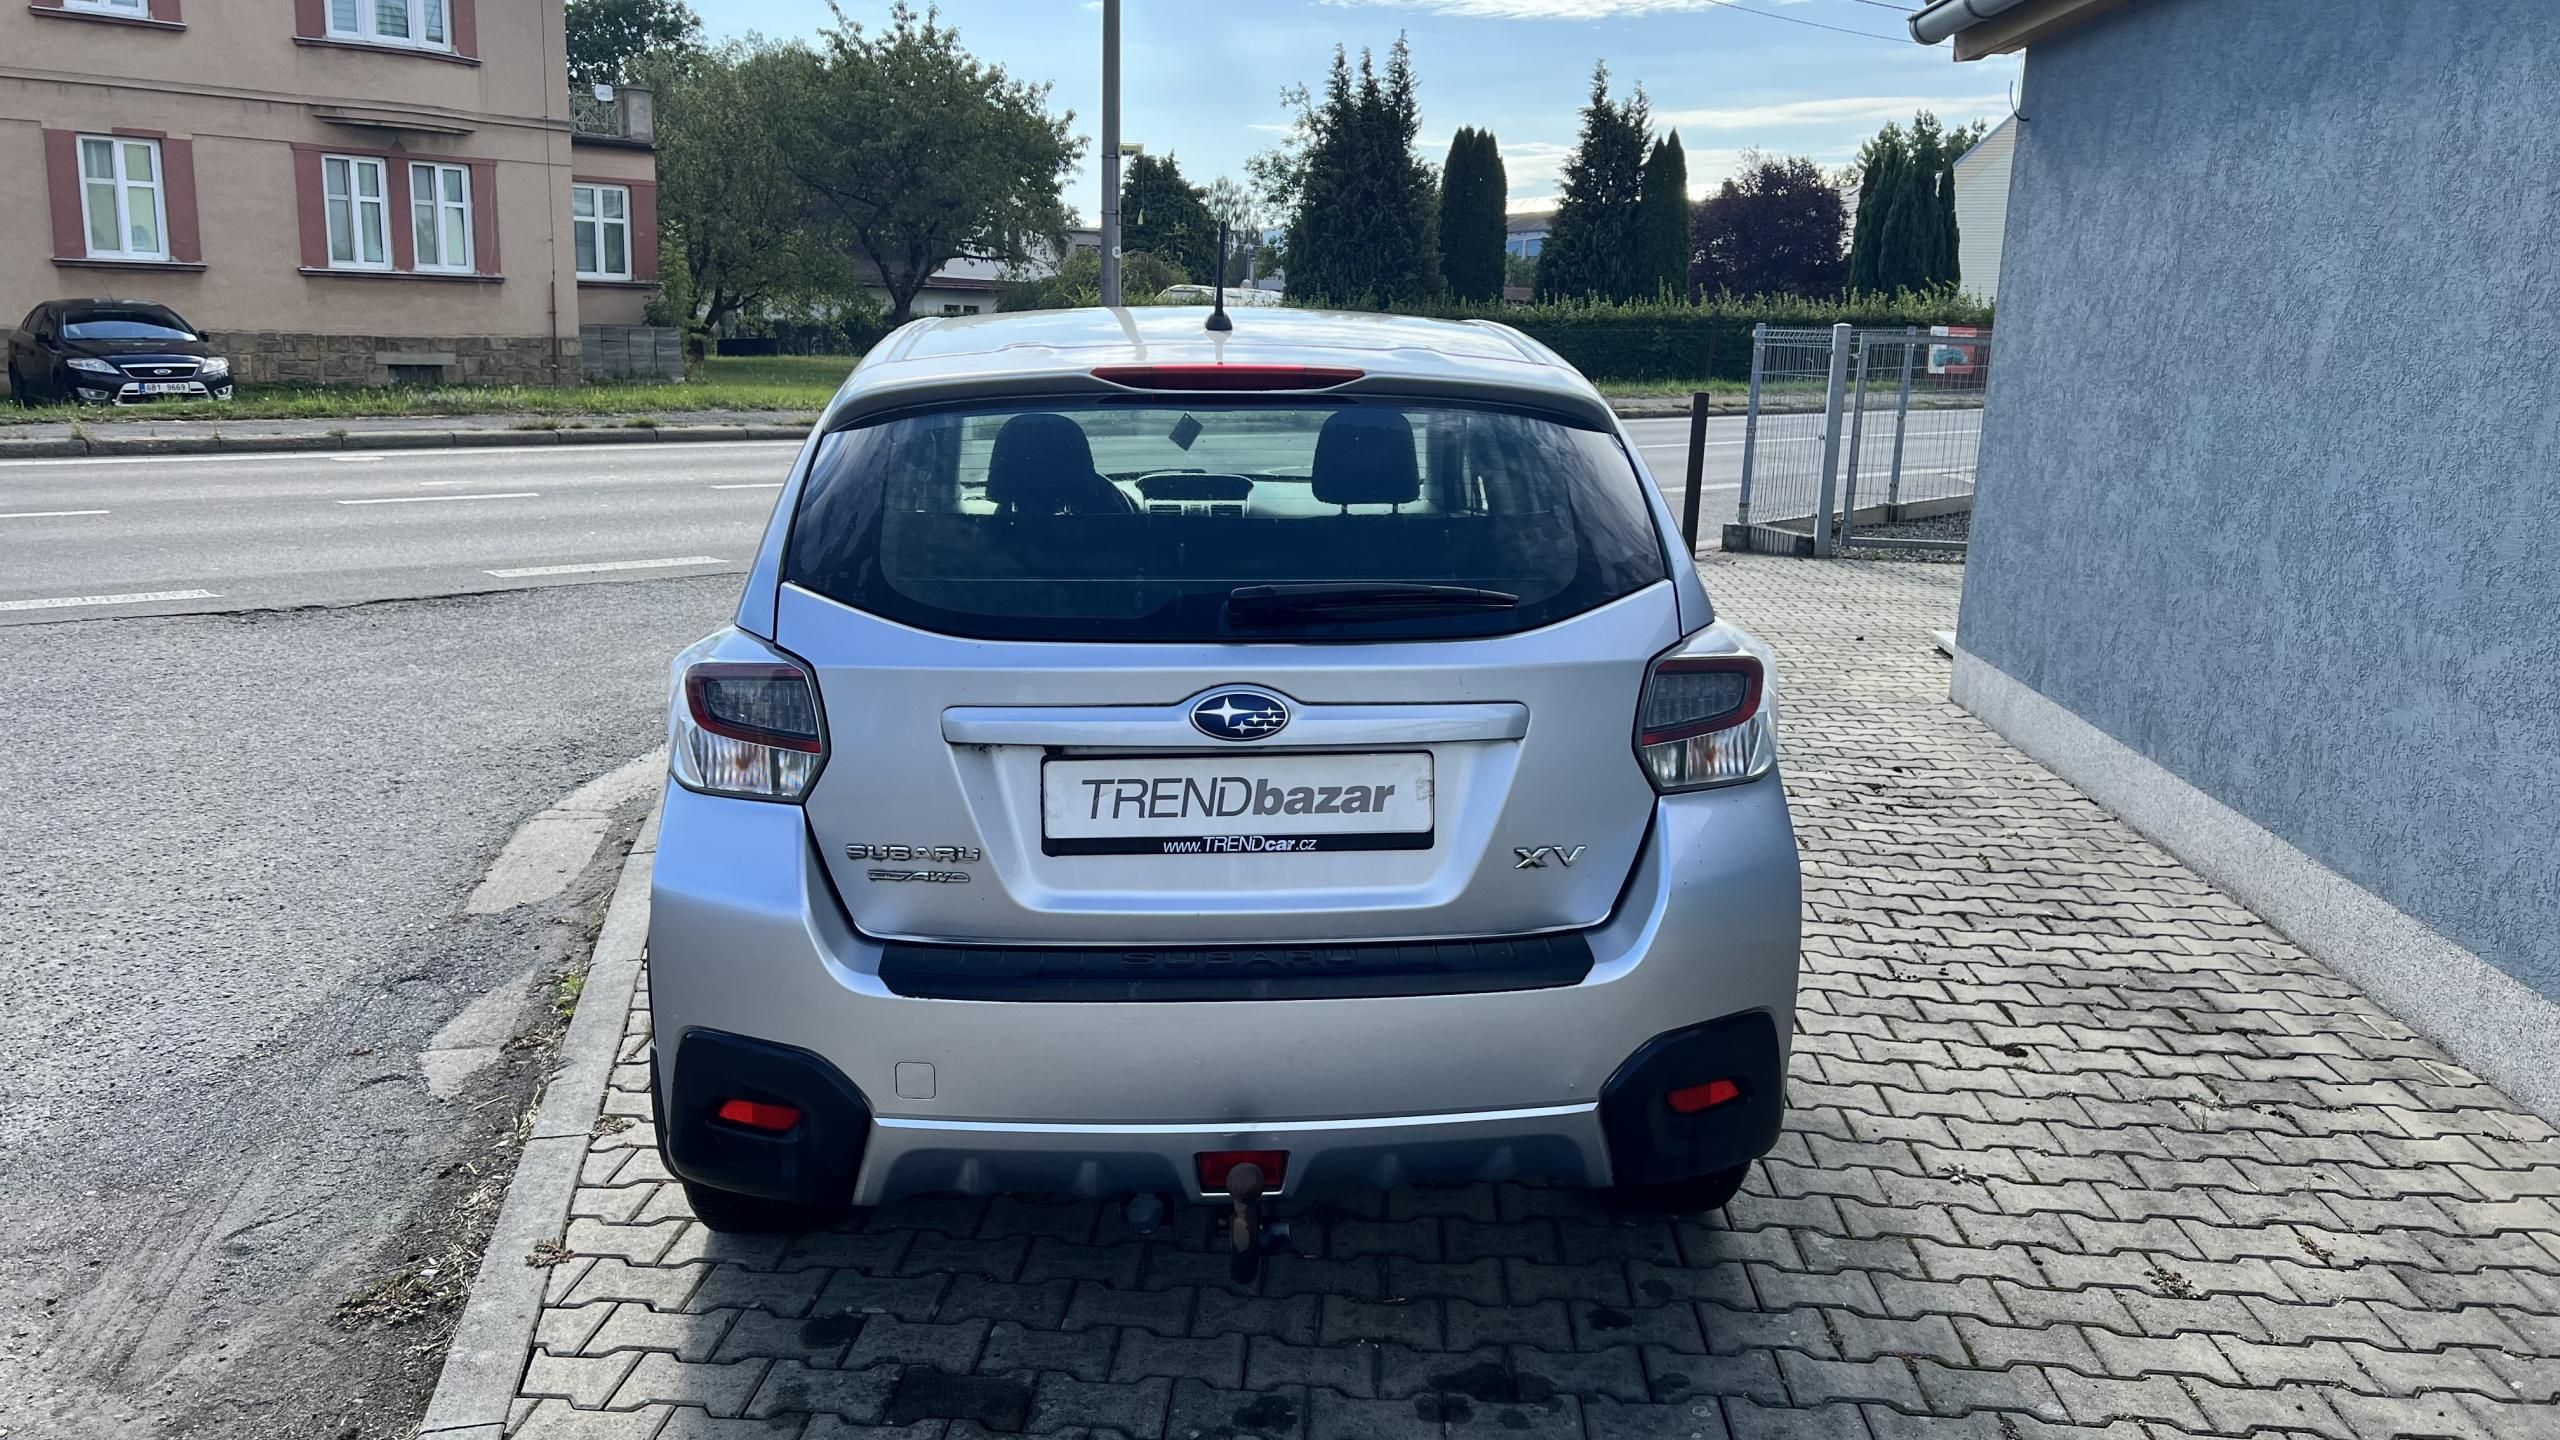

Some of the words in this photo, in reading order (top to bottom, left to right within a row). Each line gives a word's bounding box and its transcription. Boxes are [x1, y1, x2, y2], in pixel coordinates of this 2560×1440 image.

[1081, 776, 1396, 820] TRENDbazar
[846, 843, 981, 863] SUBARU
[1163, 835, 1318, 853] www.TRENDcar.cz
[1513, 844, 1587, 869] XV
[904, 871, 970, 884] AWD
[1121, 948, 1359, 969] SUBARU
